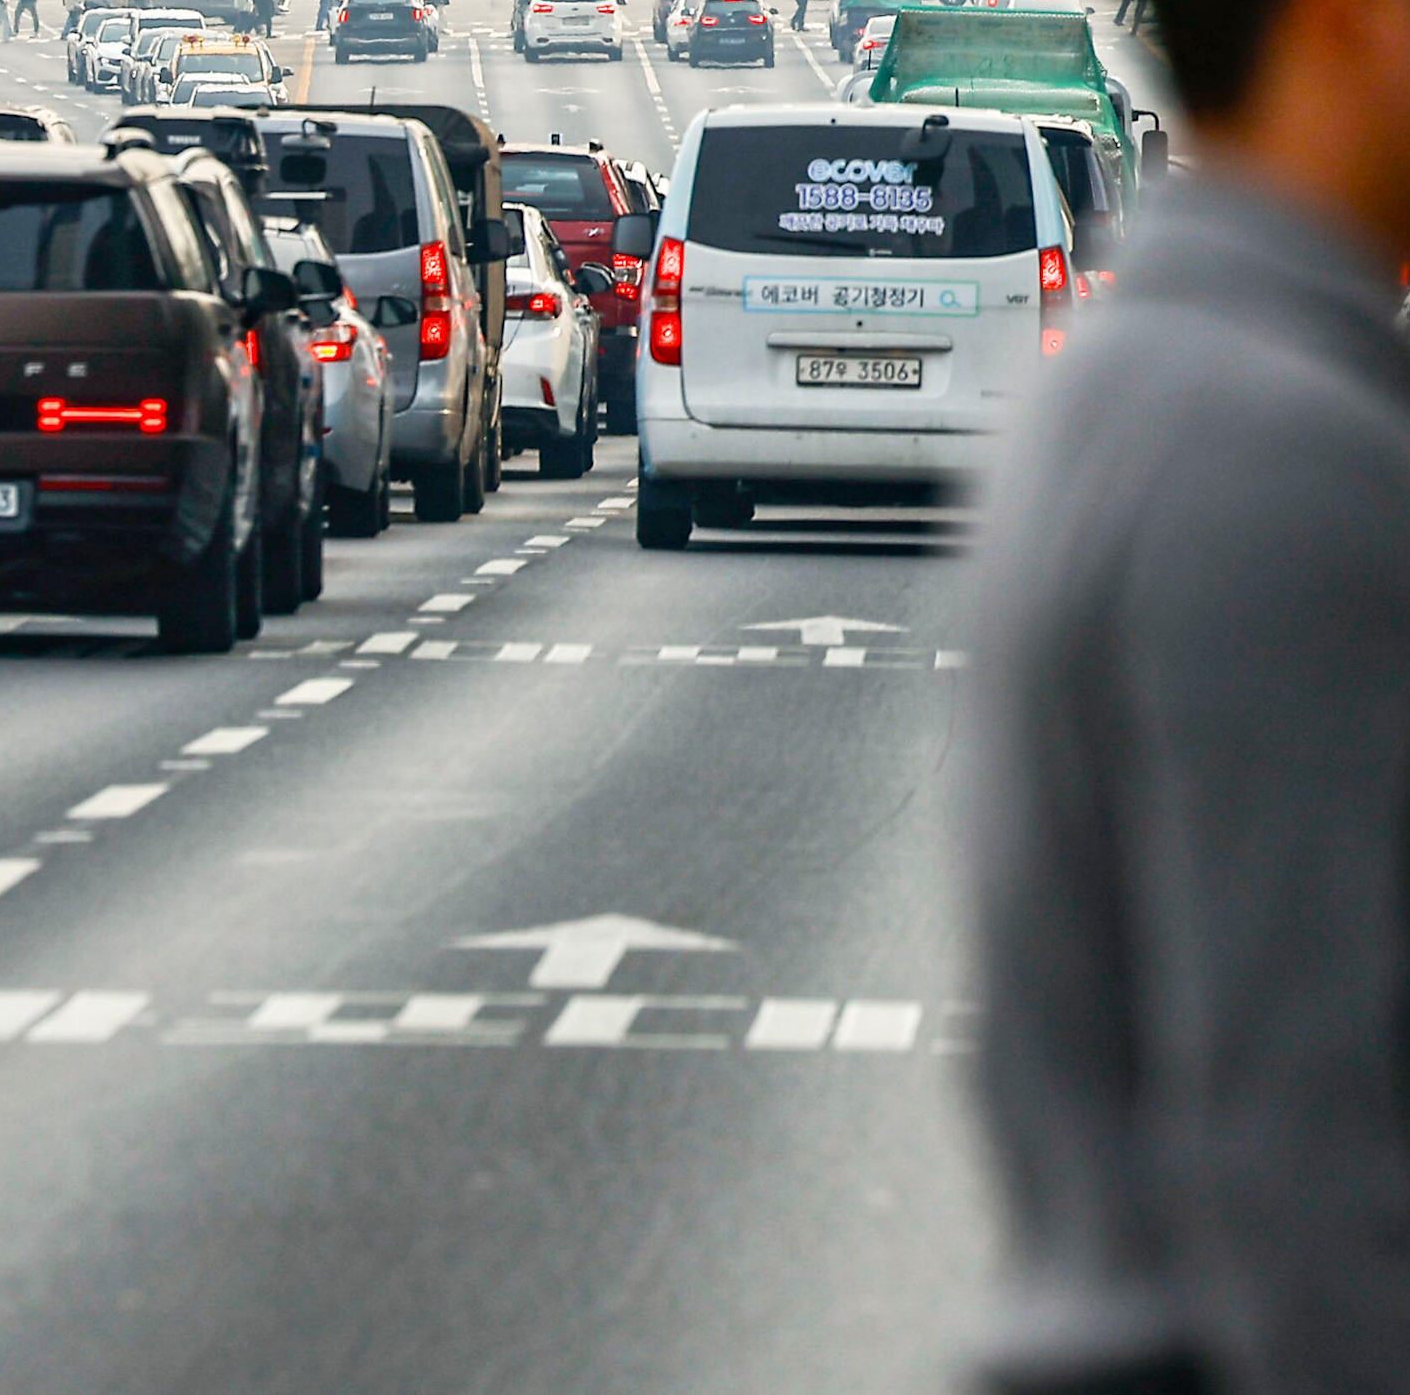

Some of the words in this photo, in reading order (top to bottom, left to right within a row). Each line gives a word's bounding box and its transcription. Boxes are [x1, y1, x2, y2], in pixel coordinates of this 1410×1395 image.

[795, 182, 933, 213] 1588-8135
[761, 284, 820, 306] 에코버
[833, 286, 925, 308] 공기청정기
[23, 361, 88, 378] FE
[857, 361, 909, 381] 3506
